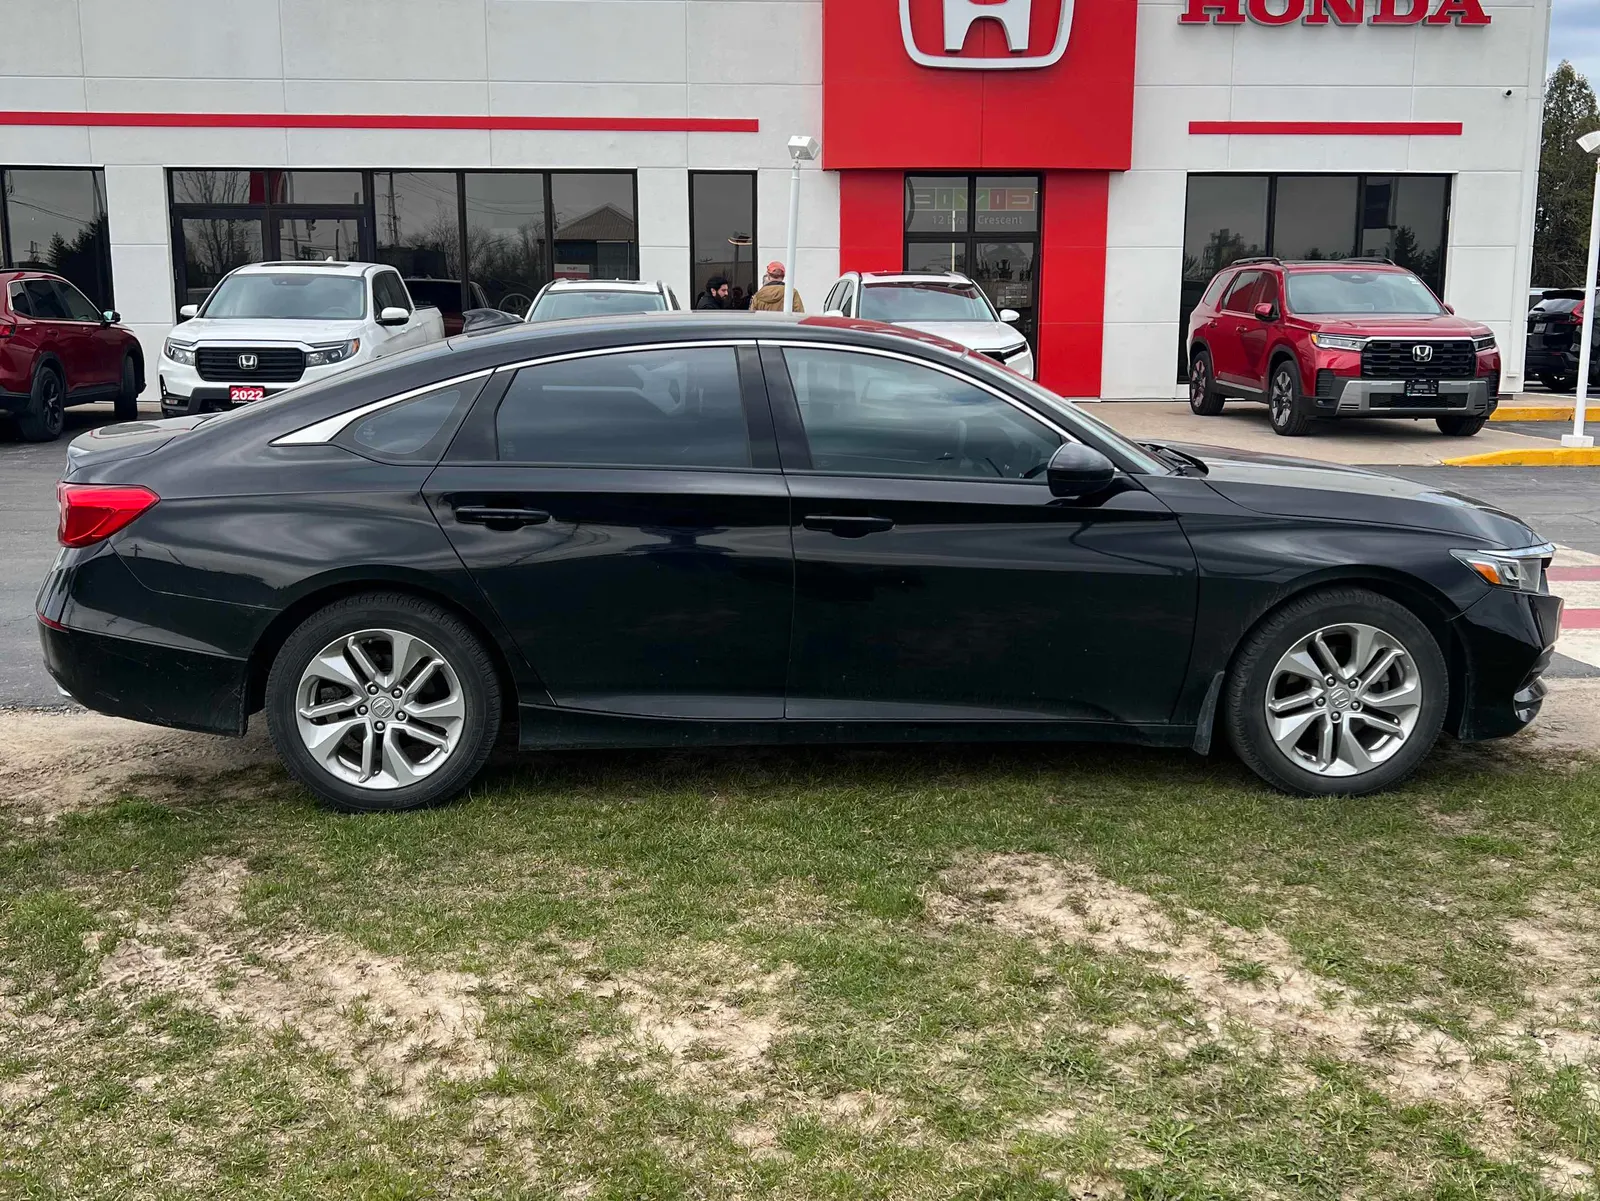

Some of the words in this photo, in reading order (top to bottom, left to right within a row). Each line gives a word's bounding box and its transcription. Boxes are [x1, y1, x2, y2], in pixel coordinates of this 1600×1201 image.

[932, 215, 945, 225] 12
[977, 214, 1023, 225] Crescent
[231, 390, 264, 400] 2022
